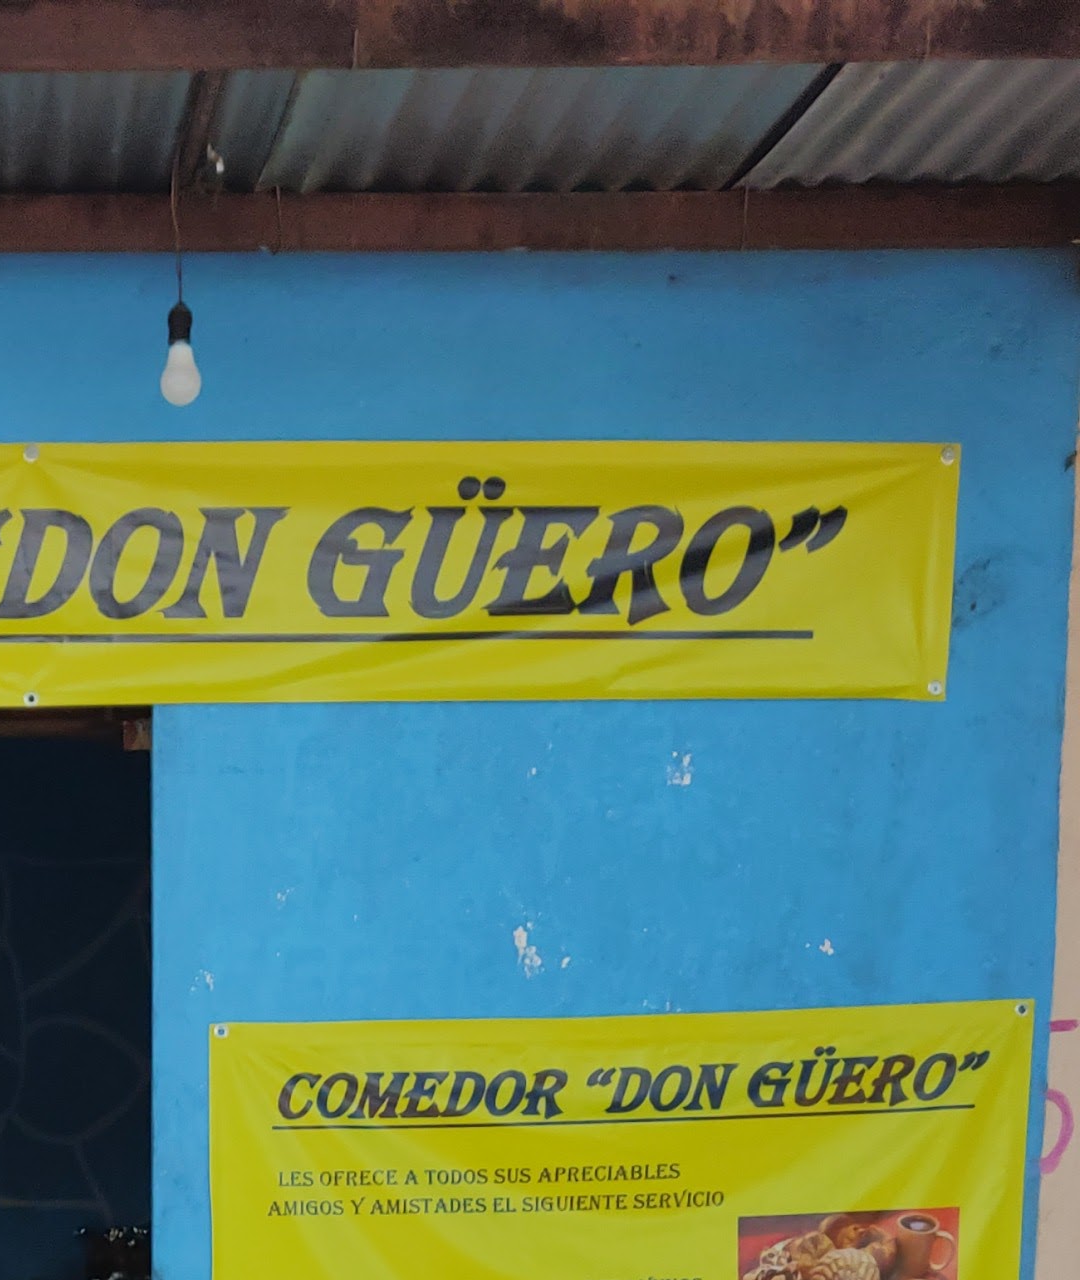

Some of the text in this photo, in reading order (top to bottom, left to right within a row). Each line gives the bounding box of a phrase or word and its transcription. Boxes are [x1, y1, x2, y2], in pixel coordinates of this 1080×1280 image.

[277, 1068, 569, 1121] COMEDOR
[278, 1163, 681, 1188] LES OFRECE A TODOS SUS APRECIABLES
[267, 1189, 725, 1217] AMIGOS Y AMISTADES EL SIGUIENTE SERVICIO
